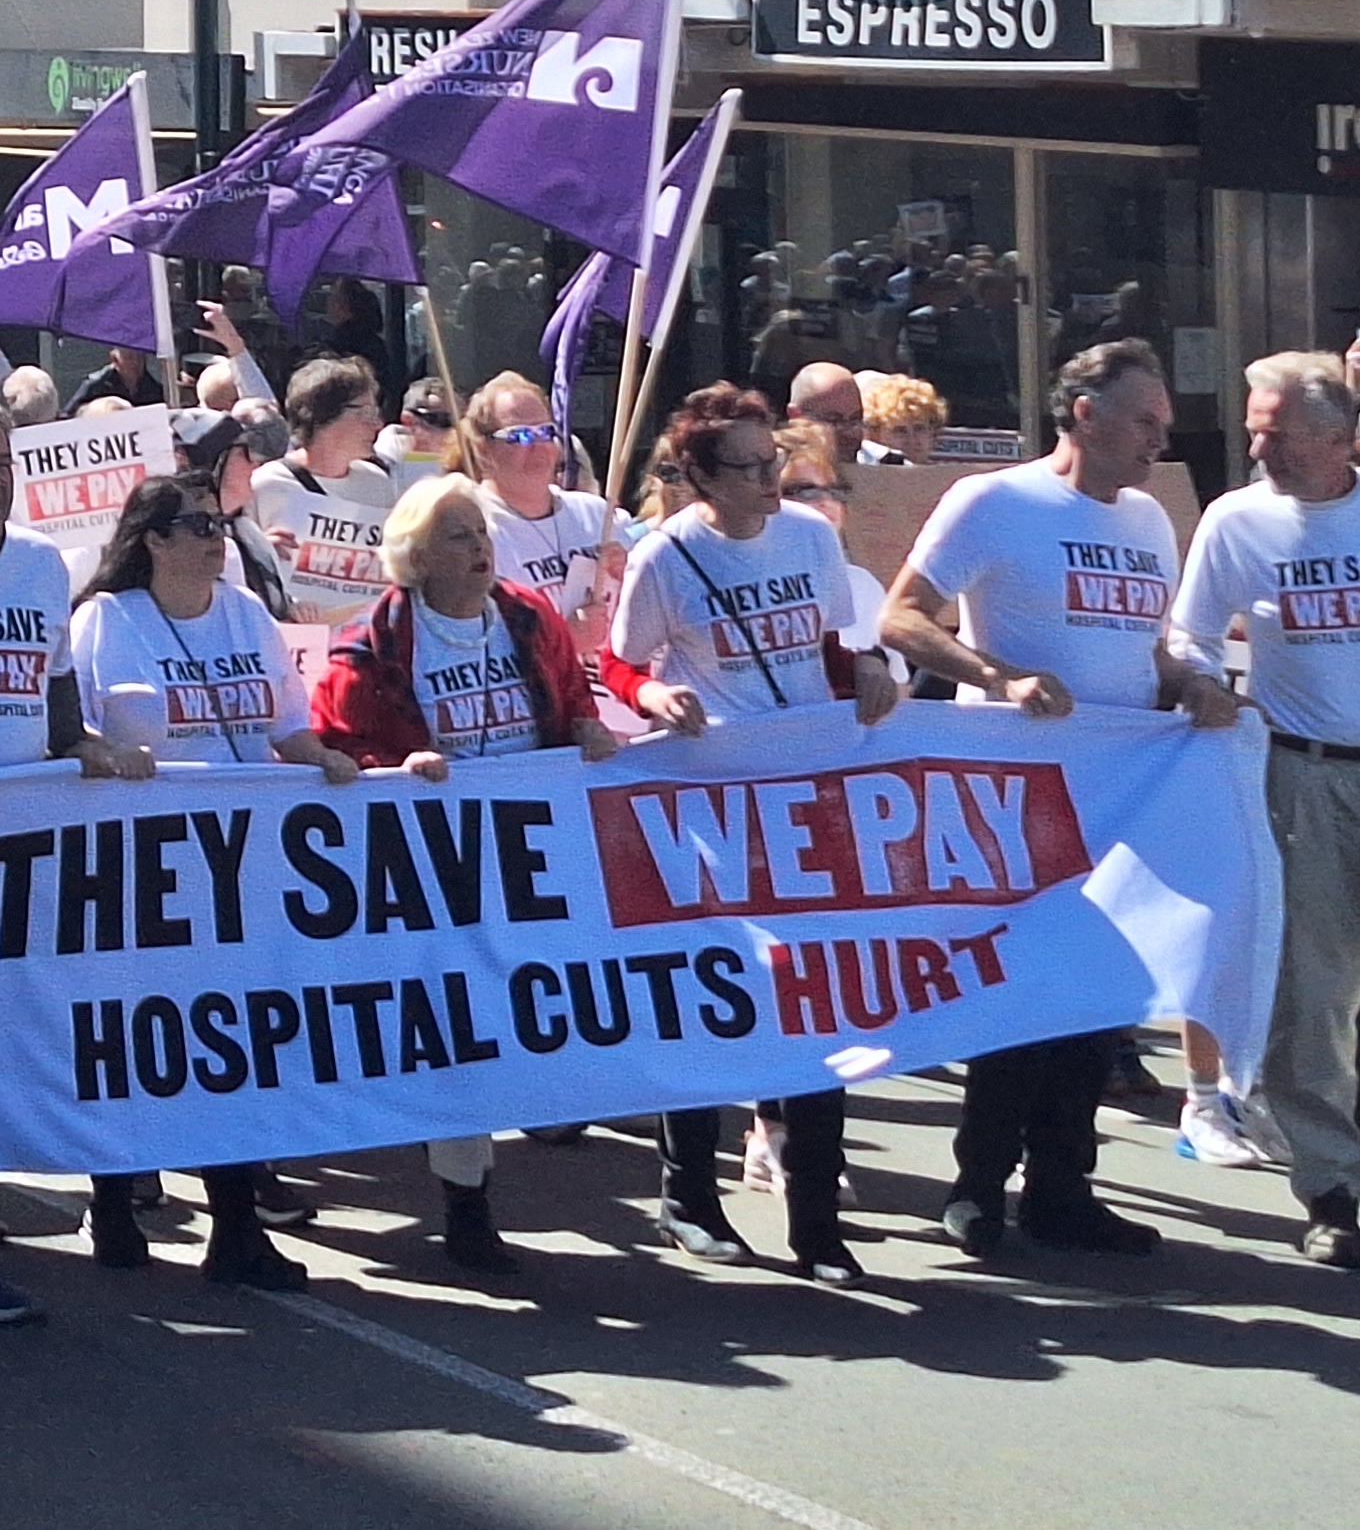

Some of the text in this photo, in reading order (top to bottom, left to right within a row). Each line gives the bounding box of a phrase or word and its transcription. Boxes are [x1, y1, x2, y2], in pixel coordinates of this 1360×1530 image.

[18, 430, 143, 476] THEY SAVE
[34, 466, 137, 517] WE PAY
[309, 512, 364, 543] THEY
[308, 546, 348, 576] WE
[1058, 540, 1118, 571] THEY
[1274, 556, 1335, 587] THEY
[767, 573, 815, 605] SAVE
[1076, 575, 1164, 616] WE PAY
[770, 606, 818, 647] PAY
[1288, 592, 1344, 627] WE
[213, 651, 266, 678] SAVE
[424, 661, 483, 695] THEY
[216, 681, 266, 719] PAY
[281, 799, 569, 940] SAVE
[630, 781, 837, 908] WE
[843, 772, 1036, 896] PAY
[71, 923, 1009, 1101] HOSPITAL CUTS HURT
